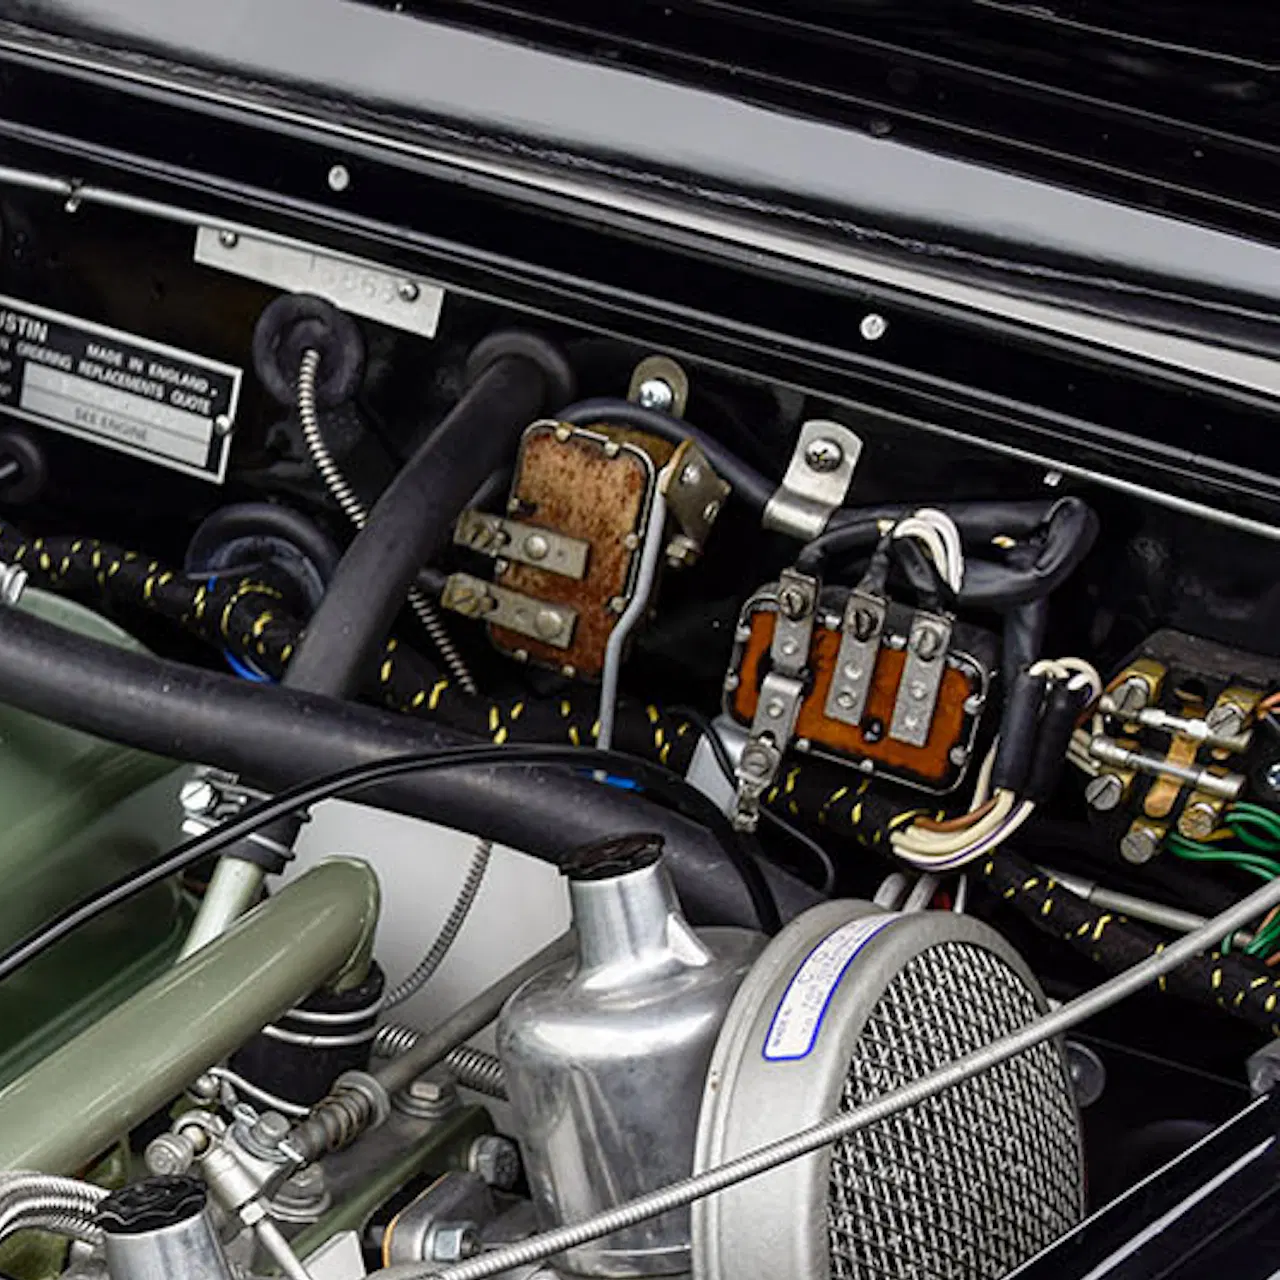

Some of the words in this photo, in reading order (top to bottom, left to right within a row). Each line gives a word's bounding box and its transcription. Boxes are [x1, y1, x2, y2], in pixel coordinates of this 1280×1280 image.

[16, 340, 73, 371] ORDERING
[77, 359, 165, 400] REPLACEMENTS
[170, 388, 211, 415] QUOTE
[86, 343, 123, 367] MADE
[128, 355, 144, 373] IN
